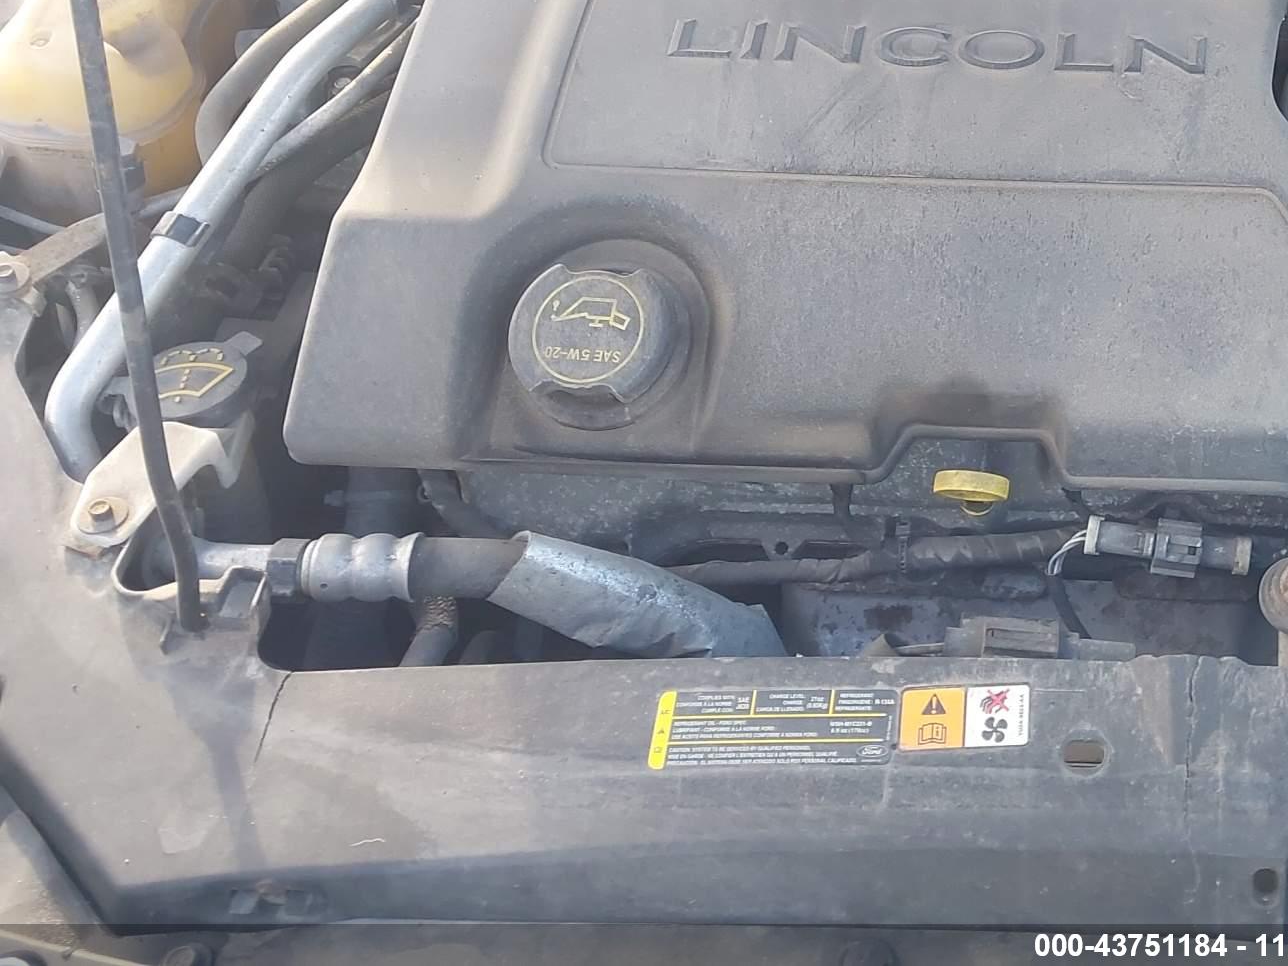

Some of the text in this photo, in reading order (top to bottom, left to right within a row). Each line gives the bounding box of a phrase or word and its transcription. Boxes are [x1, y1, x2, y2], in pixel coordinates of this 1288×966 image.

[666, 18, 1208, 75] LINCOLN
[544, 346, 623, 363] SAE 5W-20
